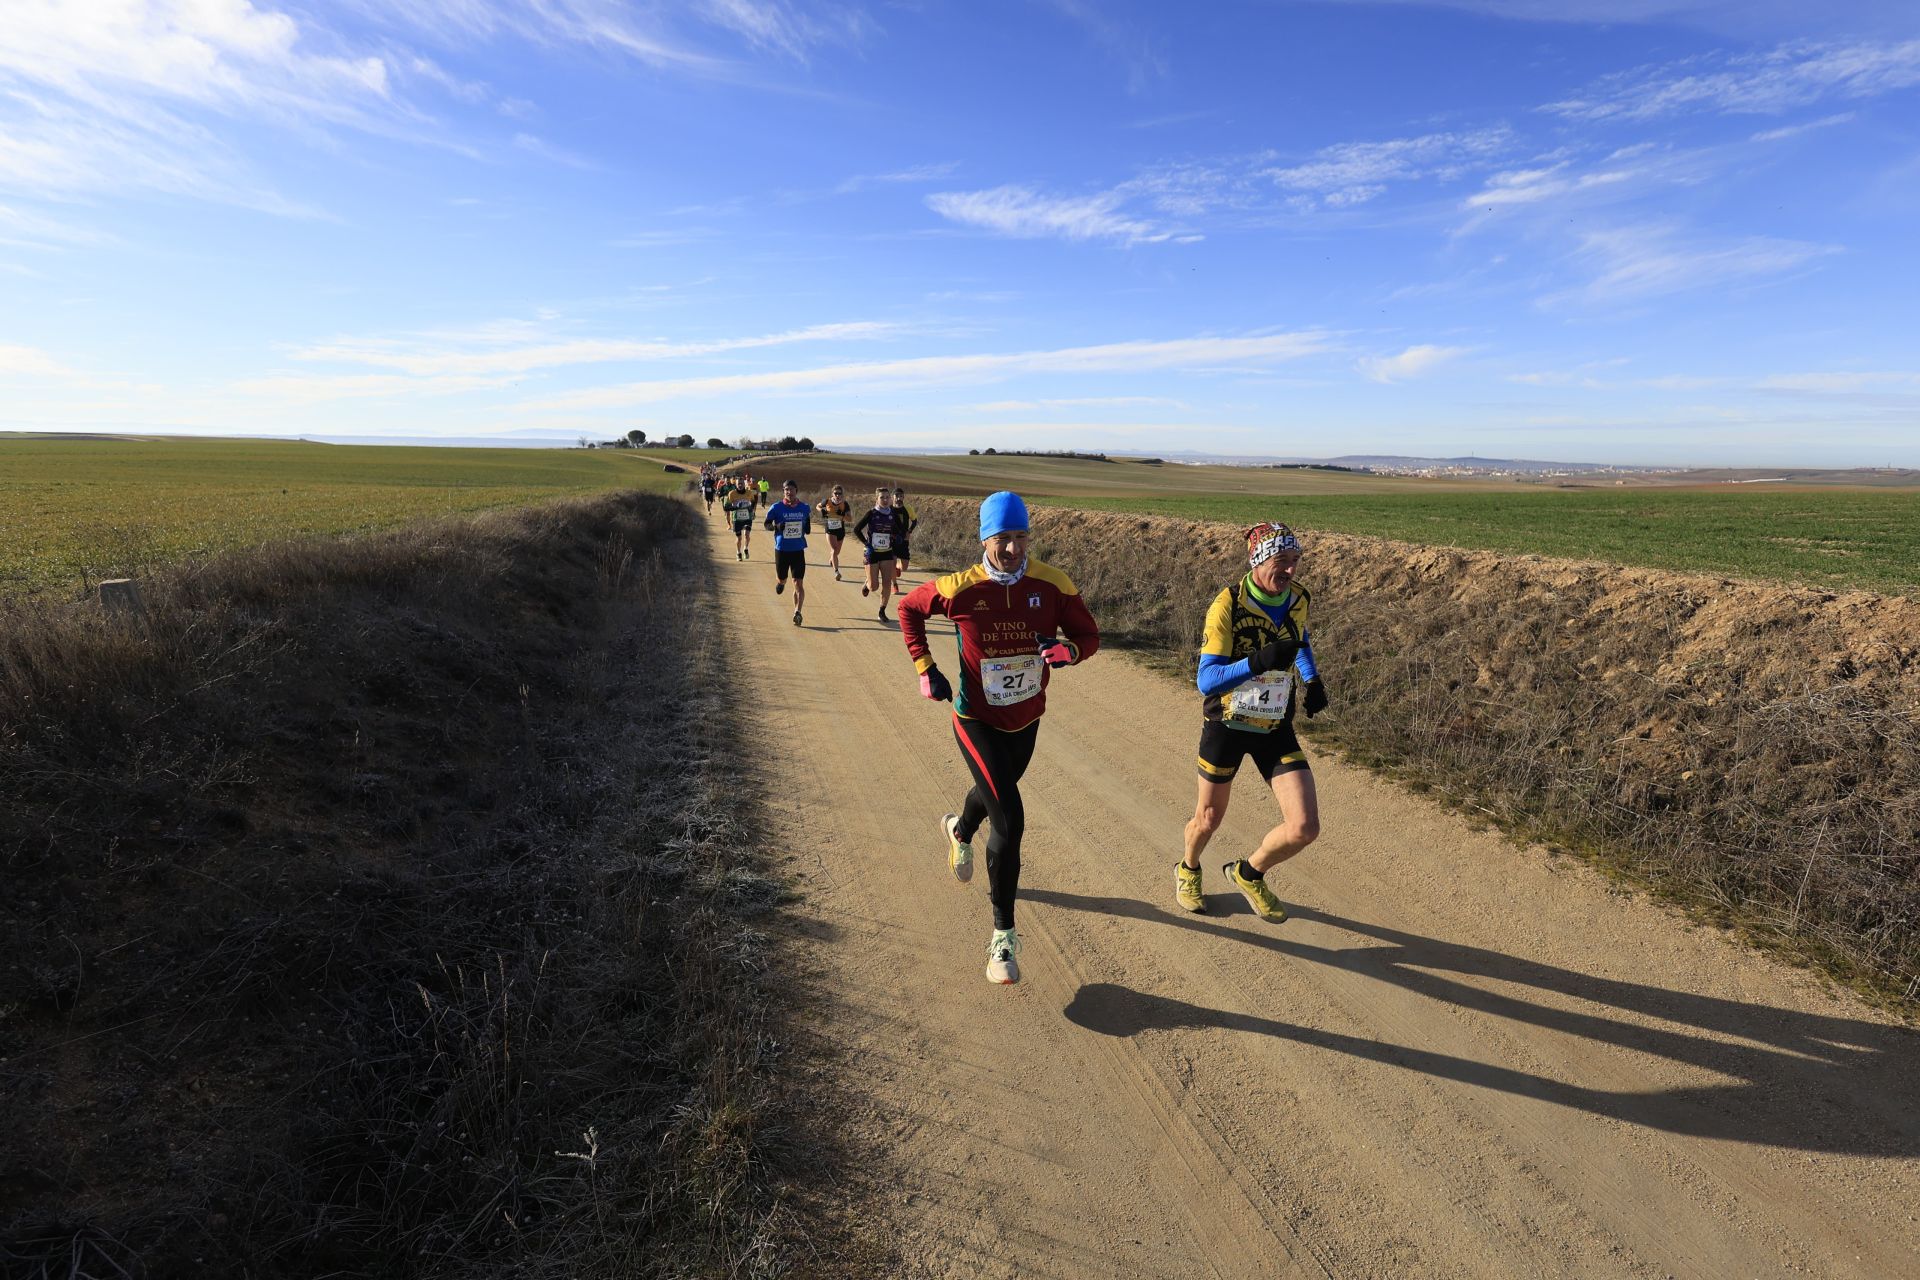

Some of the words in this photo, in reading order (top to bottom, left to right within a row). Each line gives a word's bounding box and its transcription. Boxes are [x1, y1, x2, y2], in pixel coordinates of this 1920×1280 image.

[993, 622, 1026, 631] VINO
[982, 632, 1000, 642] DE
[1001, 631, 1038, 640] TORO
[1002, 672, 1025, 689] 27
[1258, 689, 1270, 705] 4
